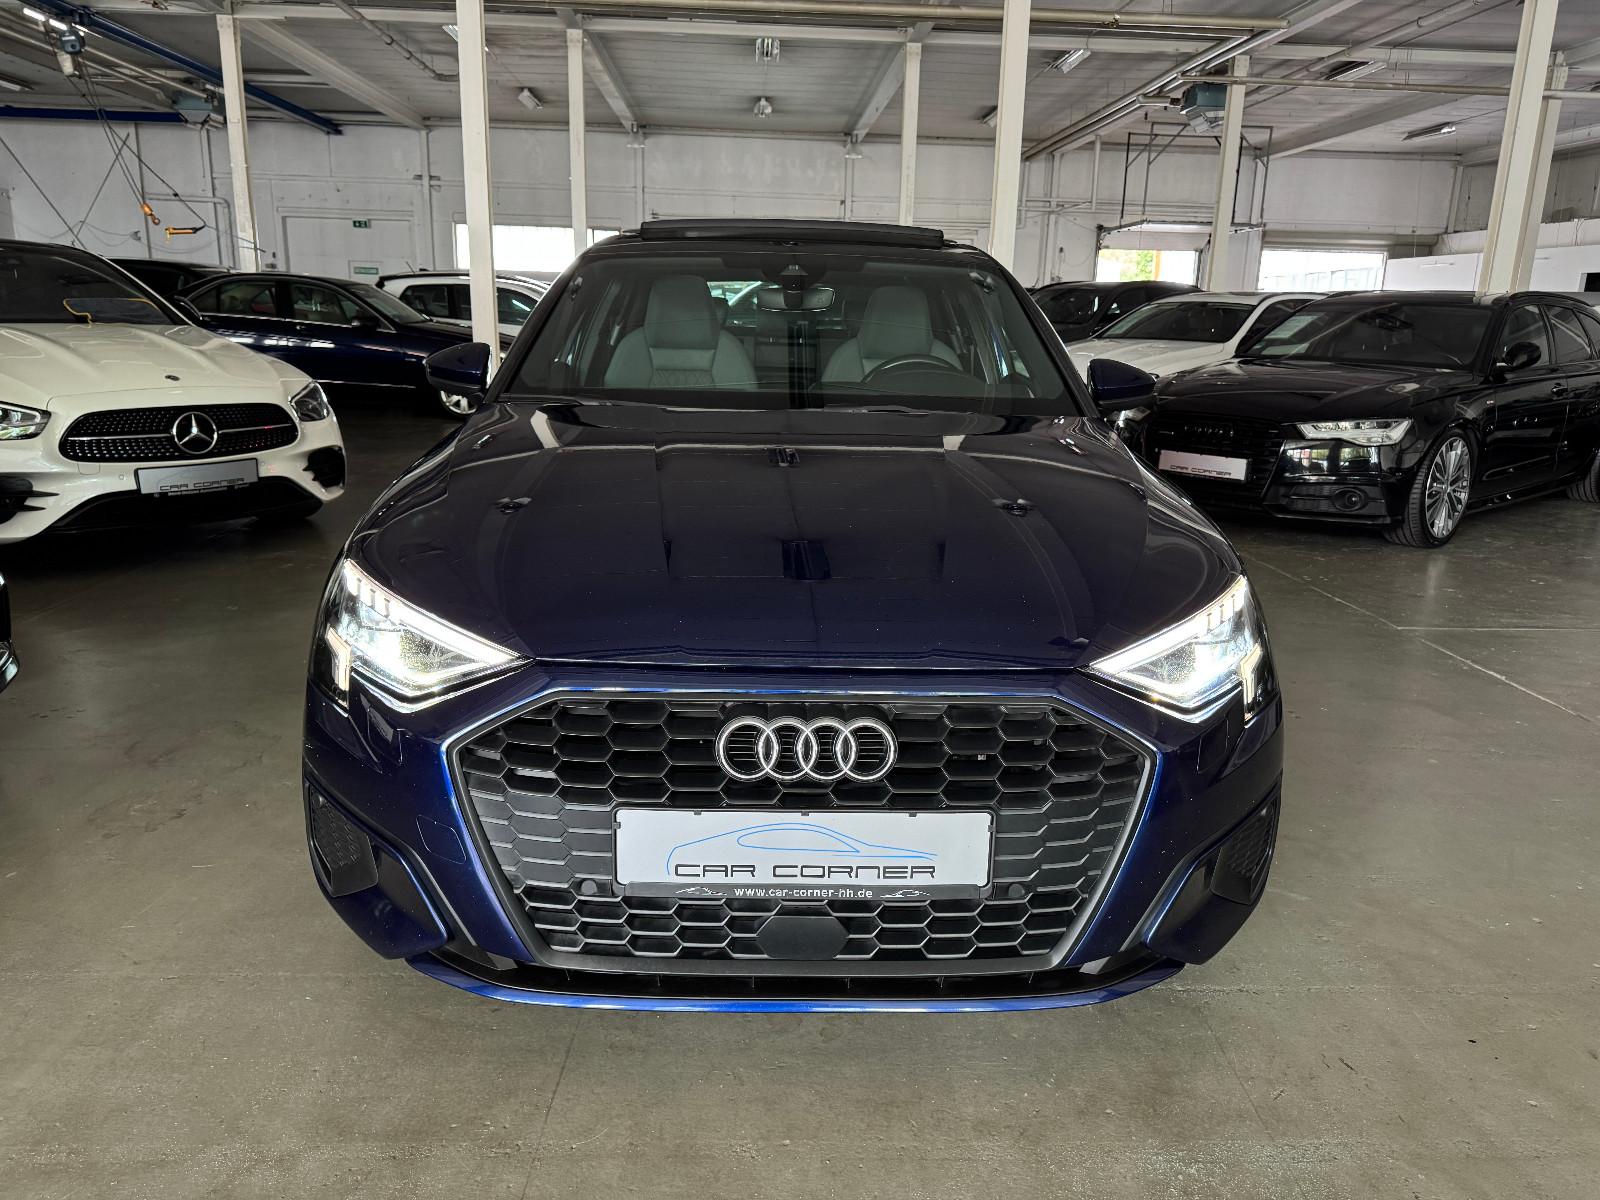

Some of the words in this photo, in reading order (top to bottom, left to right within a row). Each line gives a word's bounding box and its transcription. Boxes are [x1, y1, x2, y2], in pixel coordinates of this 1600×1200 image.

[193, 478, 245, 488] CORNER
[675, 863, 756, 878] CAR
[772, 865, 936, 879] CORNER
[733, 886, 873, 899] www.car-corner-hh.de
